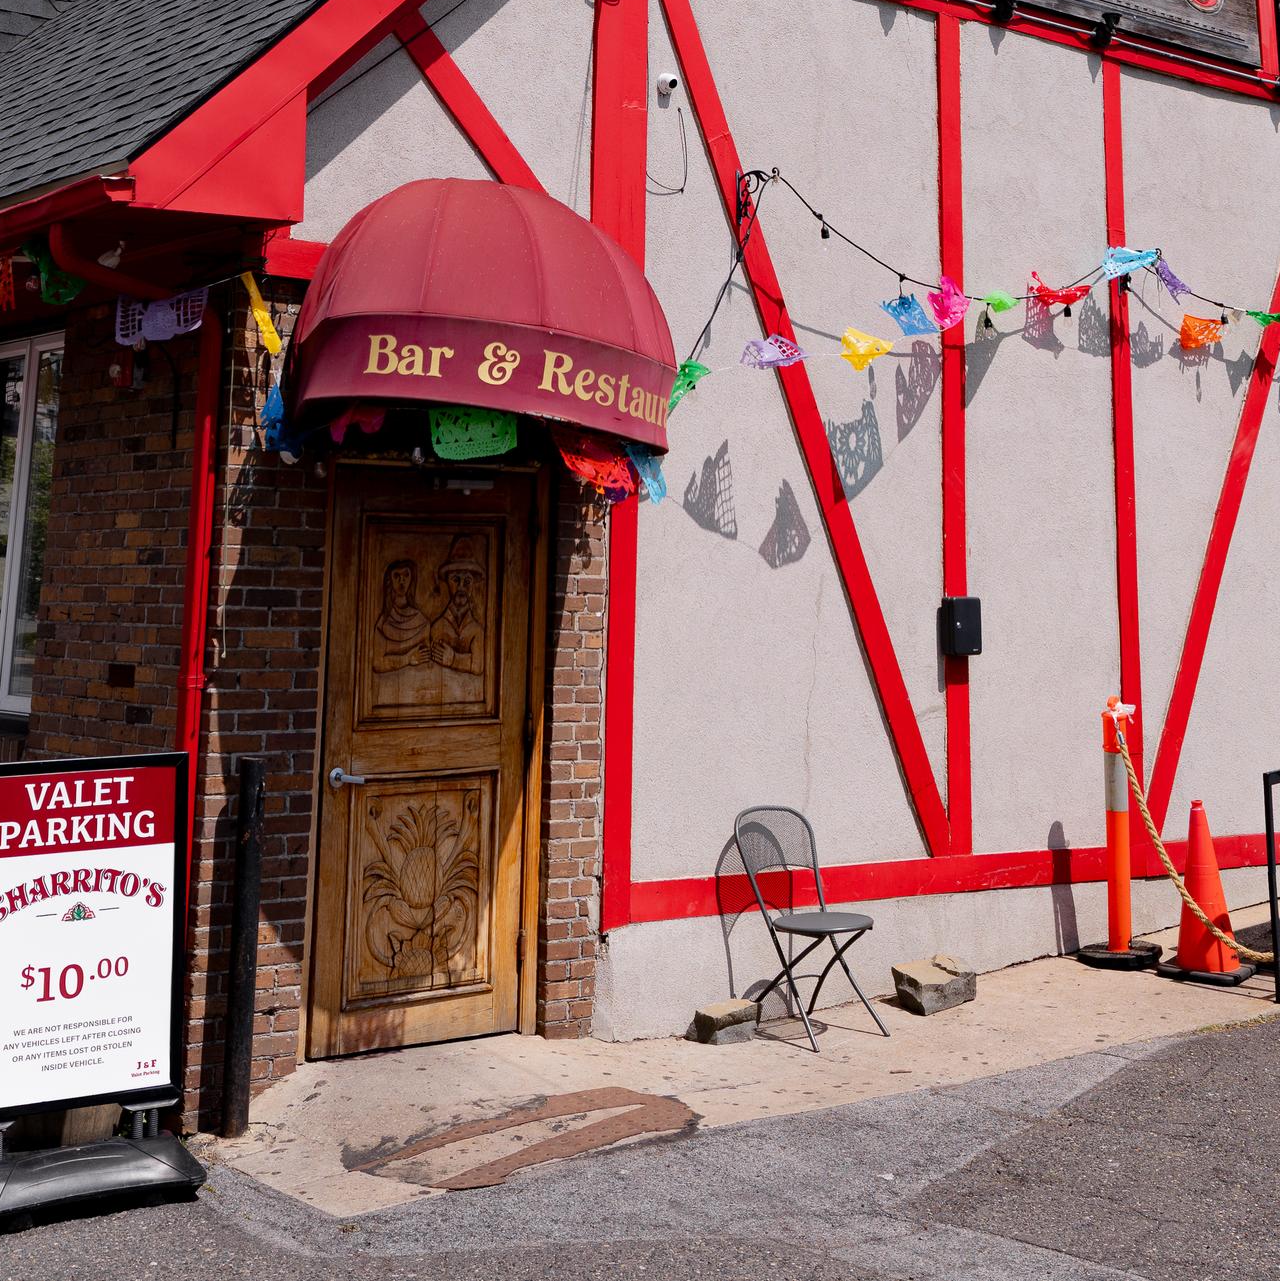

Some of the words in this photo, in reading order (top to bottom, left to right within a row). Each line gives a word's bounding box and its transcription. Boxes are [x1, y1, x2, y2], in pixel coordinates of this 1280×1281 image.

[363, 335, 454, 378] Bar
[478, 342, 521, 385] &
[24, 776, 134, 811] VALET
[13, 1029, 25, 1037] WE
[28, 1027, 42, 1035] ARE
[45, 1025, 61, 1033] NOT
[63, 1018, 116, 1030] RESPONSIBLE
[117, 1015, 133, 1023] FOR
[3, 1043, 20, 1051] ANY
[21, 1038, 60, 1049] VEHICLES
[61, 1035, 80, 1044] LEFT
[82, 1031, 106, 1041] AFTER
[108, 1027, 141, 1038] CLOSING
[12, 1055, 24, 1063] OR
[25, 1053, 42, 1061] ANY
[43, 1049, 67, 1059] ITEMS
[69, 1047, 88, 1056] LOST
[90, 1045, 101, 1053] OR
[103, 1041, 133, 1051] STOLEN
[41, 1063, 68, 1072] INSIDE
[70, 1057, 105, 1068] VEHICLE.
[137, 1061, 141, 1070] J
